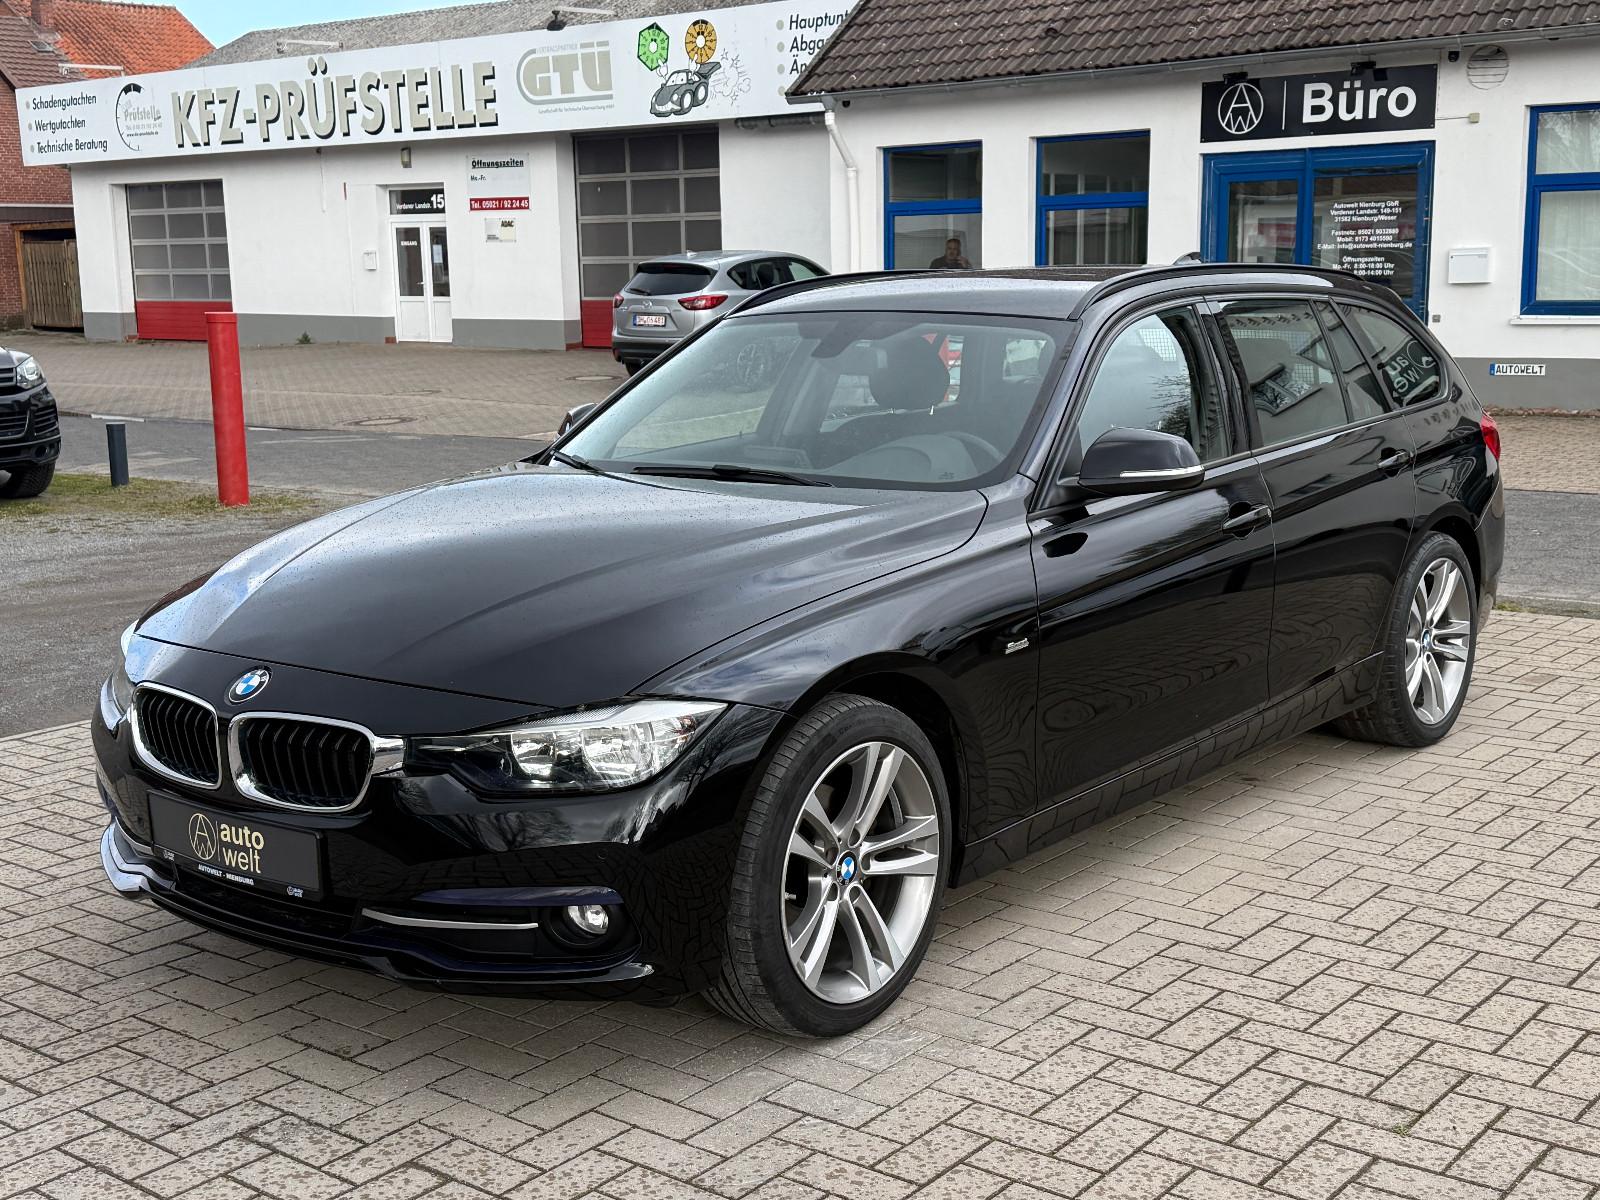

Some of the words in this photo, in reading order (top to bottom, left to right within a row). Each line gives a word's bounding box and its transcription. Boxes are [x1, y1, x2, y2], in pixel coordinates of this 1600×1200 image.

[522, 41, 613, 97] GTÜ
[32, 94, 97, 111] Schadengutachten
[171, 57, 498, 148] KFZ-PRÜFSTELLE
[1302, 80, 1417, 124] Büro
[35, 118, 86, 134] Wertgutachten
[37, 141, 73, 154] Technische
[75, 138, 108, 153] Beratung
[471, 157, 524, 169] Öffnungszeiten
[471, 201, 481, 209] Tel.
[1495, 364, 1544, 375] AUTOWELT
[220, 823, 265, 850] auto
[222, 847, 261, 874] welt
